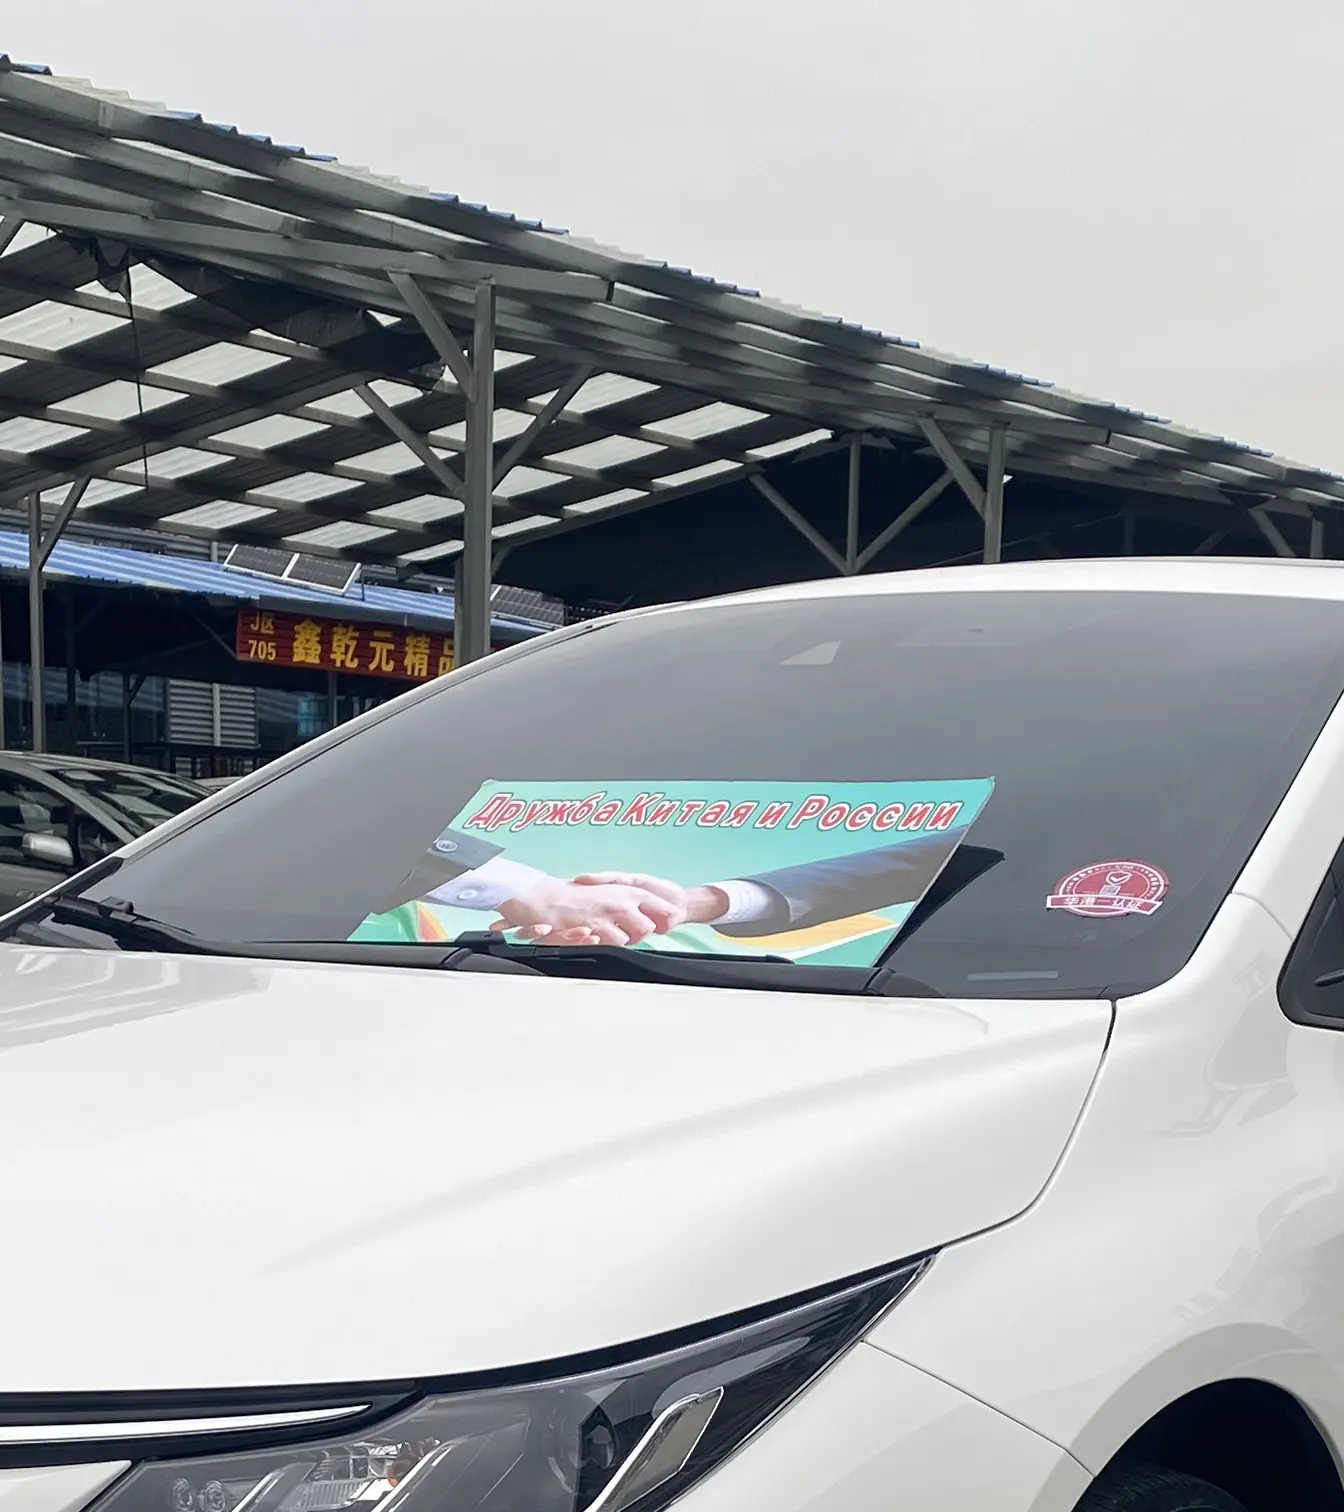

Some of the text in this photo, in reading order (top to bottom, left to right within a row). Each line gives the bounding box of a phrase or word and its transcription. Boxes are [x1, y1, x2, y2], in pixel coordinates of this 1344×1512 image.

[247, 638, 277, 661] 705
[462, 791, 964, 832] Дружба Китая и России
